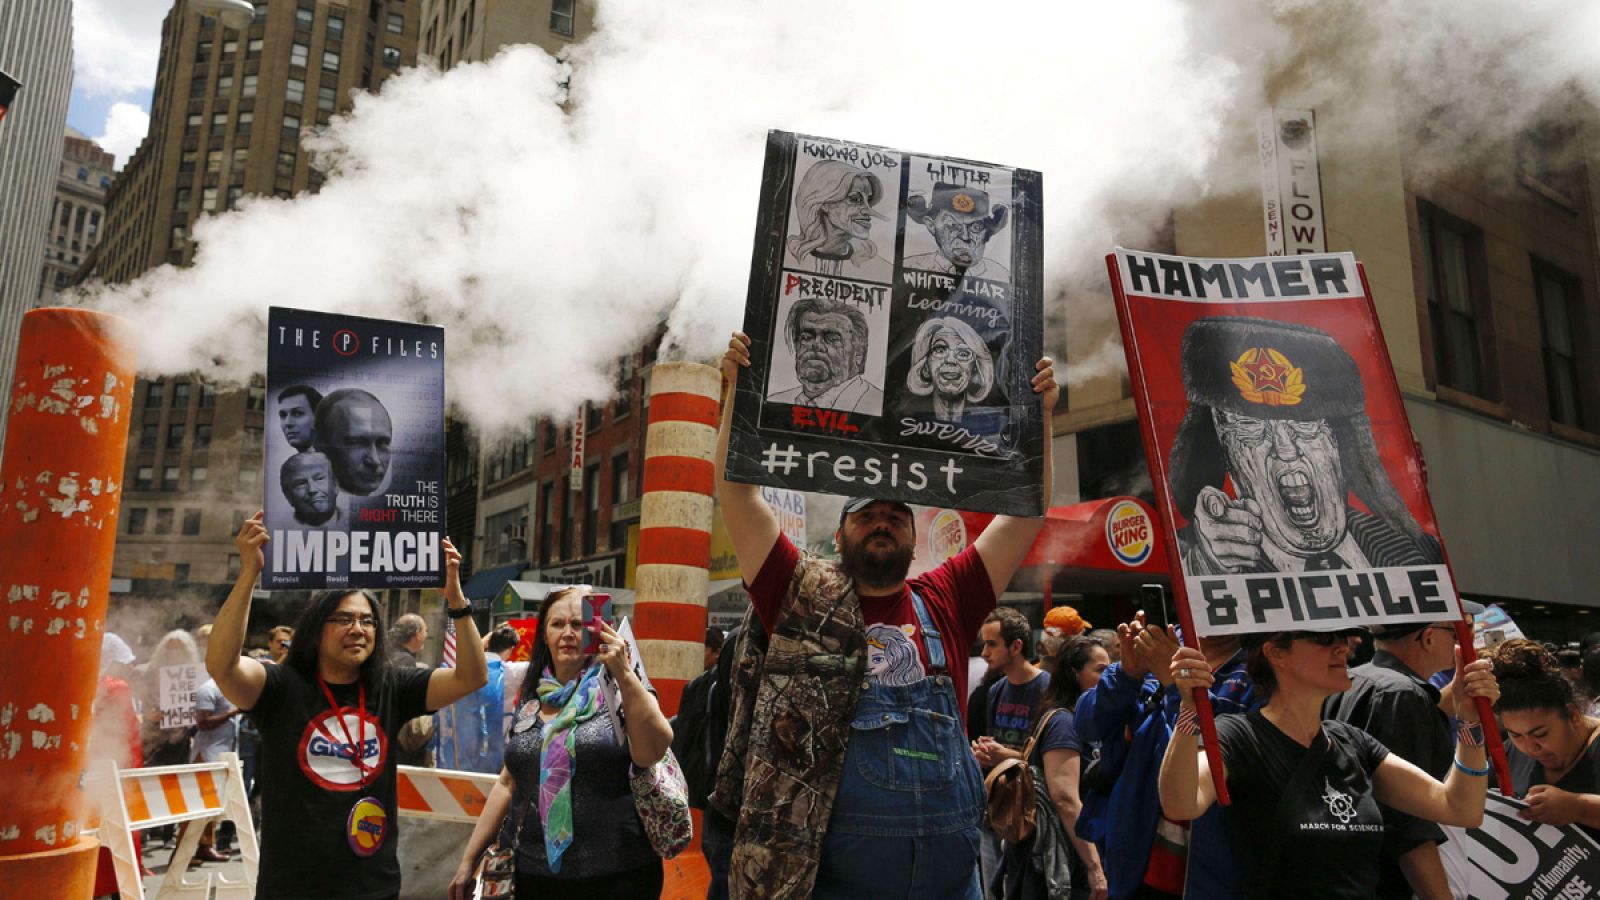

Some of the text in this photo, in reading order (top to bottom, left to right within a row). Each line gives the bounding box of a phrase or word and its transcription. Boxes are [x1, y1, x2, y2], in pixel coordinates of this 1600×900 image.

[803, 142, 897, 170] KNOWS JOB
[927, 162, 991, 186] LITTLE
[1268, 200, 1277, 242] SENT
[903, 271, 1005, 299] WHITE LIAR
[1126, 254, 1350, 298] HAMMER
[785, 273, 888, 308] PRESIDENT
[907, 292, 1003, 328] Learning
[280, 326, 321, 350] THE
[372, 336, 438, 359] FILES
[791, 406, 859, 434] EVIL
[573, 405, 583, 469] IZZA
[900, 417, 998, 458] Swerve
[761, 442, 965, 494] #resist
[386, 494, 439, 509] TRUTH IS
[416, 481, 439, 494] THE
[361, 508, 438, 523] RIGHT THERE
[1112, 516, 1146, 534] BURGER
[272, 530, 439, 573] IMPEACH
[1115, 526, 1149, 549] KING
[272, 575, 299, 584] Persist
[327, 575, 349, 584] Resist
[1200, 568, 1449, 626] & PICKLE
[167, 668, 196, 680] WE
[170, 681, 195, 692] ARE
[170, 693, 197, 704] THE
[161, 707, 197, 728] MAJOR
[1300, 823, 1329, 831] MARCH
[1331, 823, 1346, 832] FOR
[1350, 824, 1378, 832] SCIENCE
[1531, 844, 1590, 900] of Humanity,
